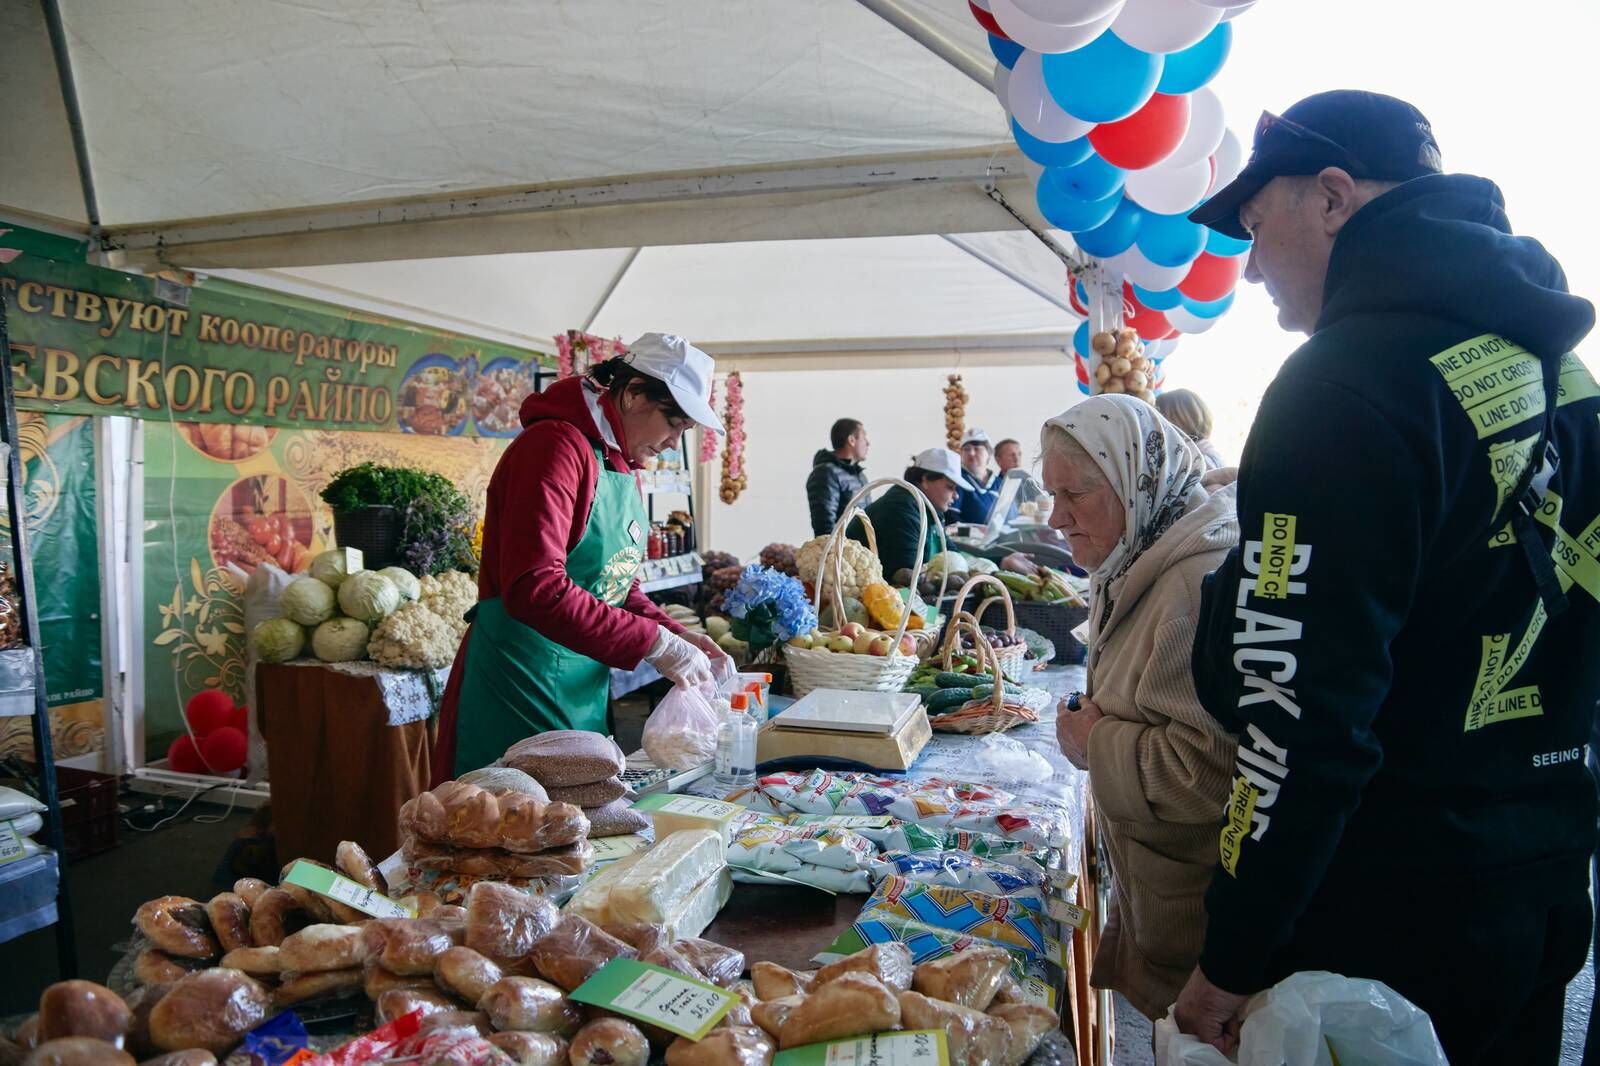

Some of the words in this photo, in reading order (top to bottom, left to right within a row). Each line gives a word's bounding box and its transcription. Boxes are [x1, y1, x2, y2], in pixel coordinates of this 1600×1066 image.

[198, 313, 398, 373] кооператоры
[1459, 348, 1481, 364] DO
[1479, 338, 1505, 356] NOT
[263, 367, 392, 424] РАЙПО
[1474, 372, 1502, 393] NOT
[1479, 404, 1510, 428] LINE
[1510, 396, 1529, 415] DO
[1273, 517, 1288, 540] DO
[1269, 545, 1285, 577] NOT
[1498, 694, 1527, 713] LINE
[1533, 747, 1580, 768] SEEING
[1234, 782, 1250, 818] FIRE
[1224, 816, 1244, 848] LINE
